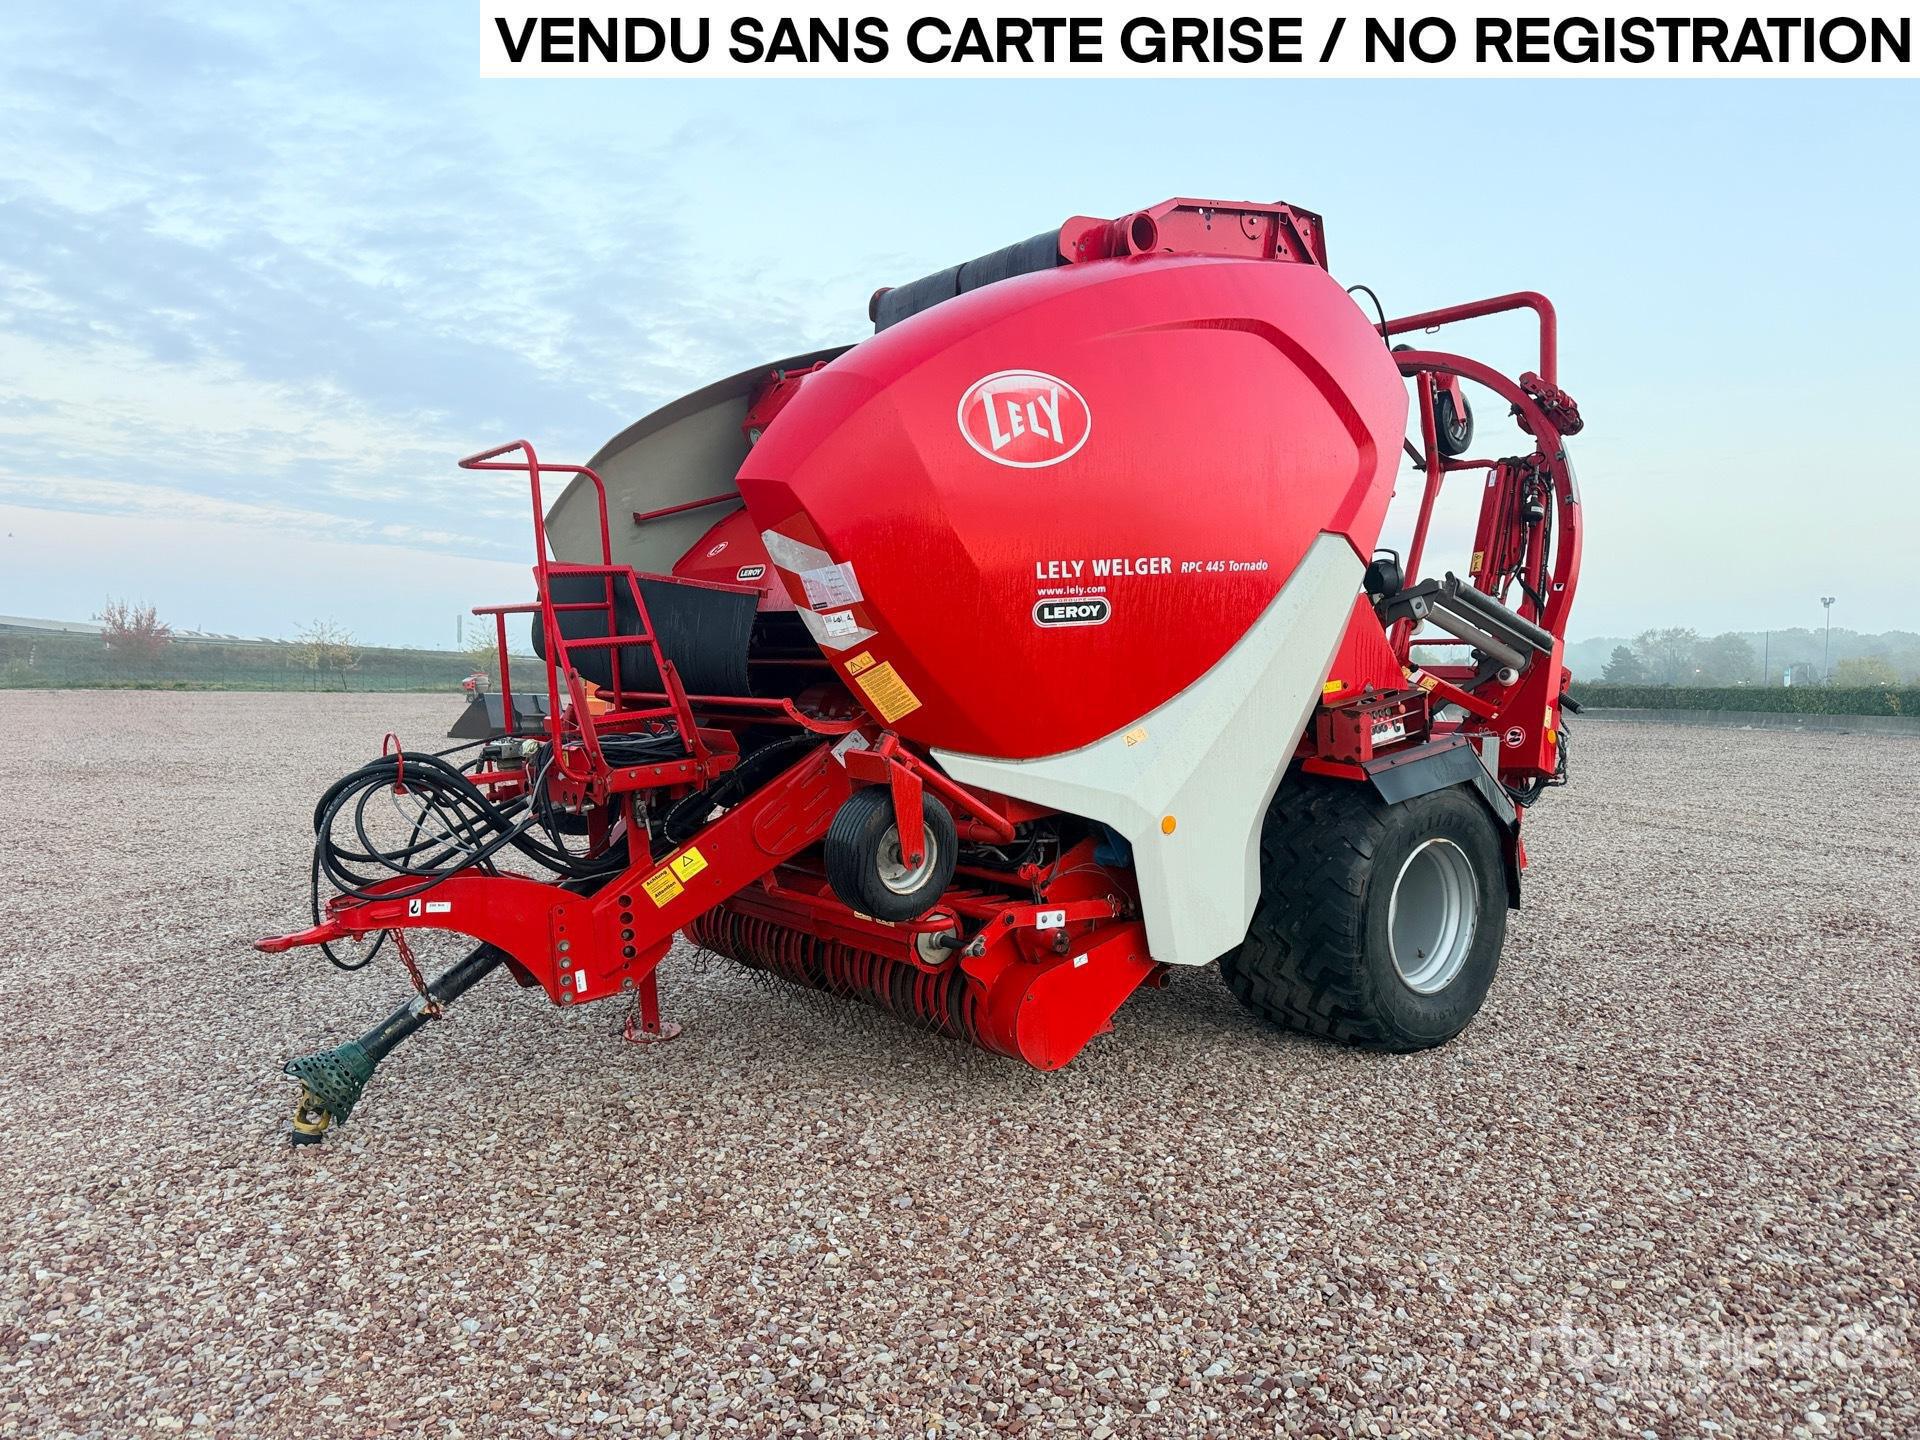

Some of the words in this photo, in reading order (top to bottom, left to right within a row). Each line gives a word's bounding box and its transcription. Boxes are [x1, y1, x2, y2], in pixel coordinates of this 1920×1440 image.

[981, 386, 1064, 452] LELY
[740, 568, 762, 577] LEROY
[1036, 560, 1085, 579] LELY
[1092, 557, 1172, 576] WELGER
[1181, 561, 1202, 573] RPC
[1206, 560, 1225, 572] 445
[1229, 559, 1269, 572] Tornado
[1037, 585, 1107, 596] www.lely.com
[1043, 604, 1101, 619] LEROY
[646, 870, 668, 886] Achtung
[655, 881, 677, 898] Attention
